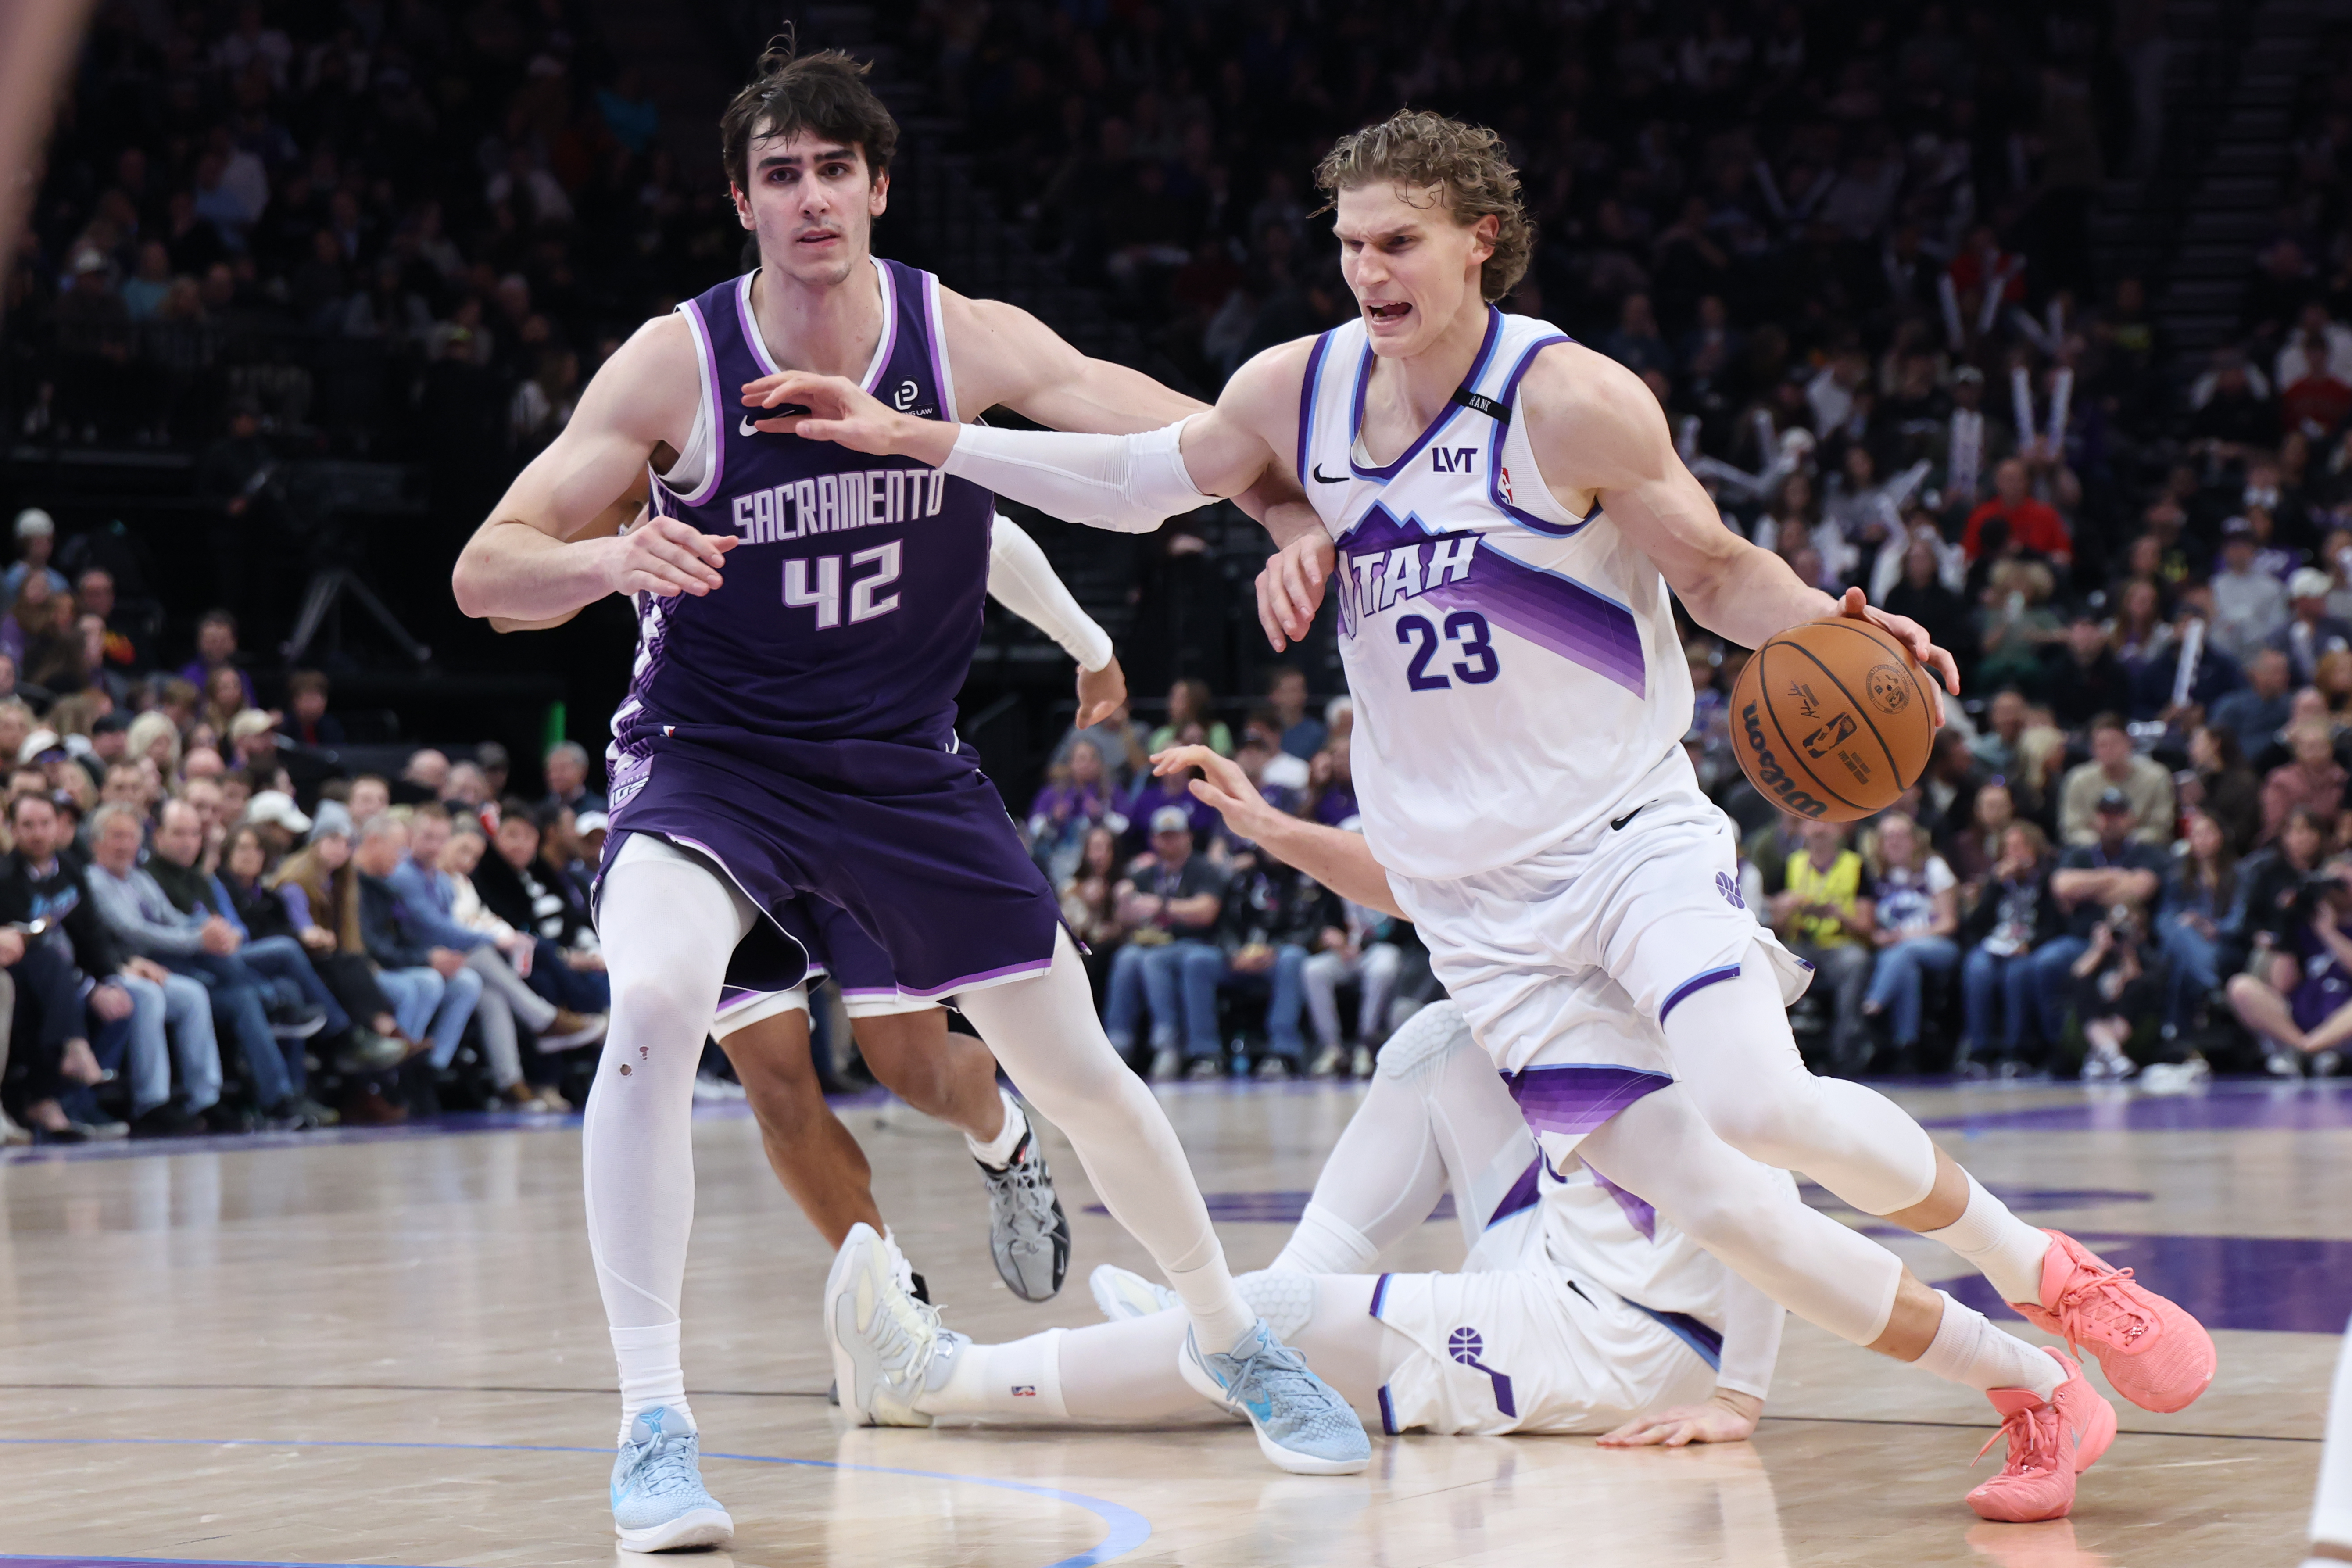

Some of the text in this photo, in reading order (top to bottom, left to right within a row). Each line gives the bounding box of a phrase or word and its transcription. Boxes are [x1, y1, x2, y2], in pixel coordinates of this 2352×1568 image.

[1432, 447, 1478, 473] LVT
[732, 469, 945, 546] SACRAMENTO
[782, 538, 903, 631] 42
[1339, 533, 1486, 641] UTAH
[1396, 610, 1500, 692] 23
[1743, 699, 1828, 818] Wilson
